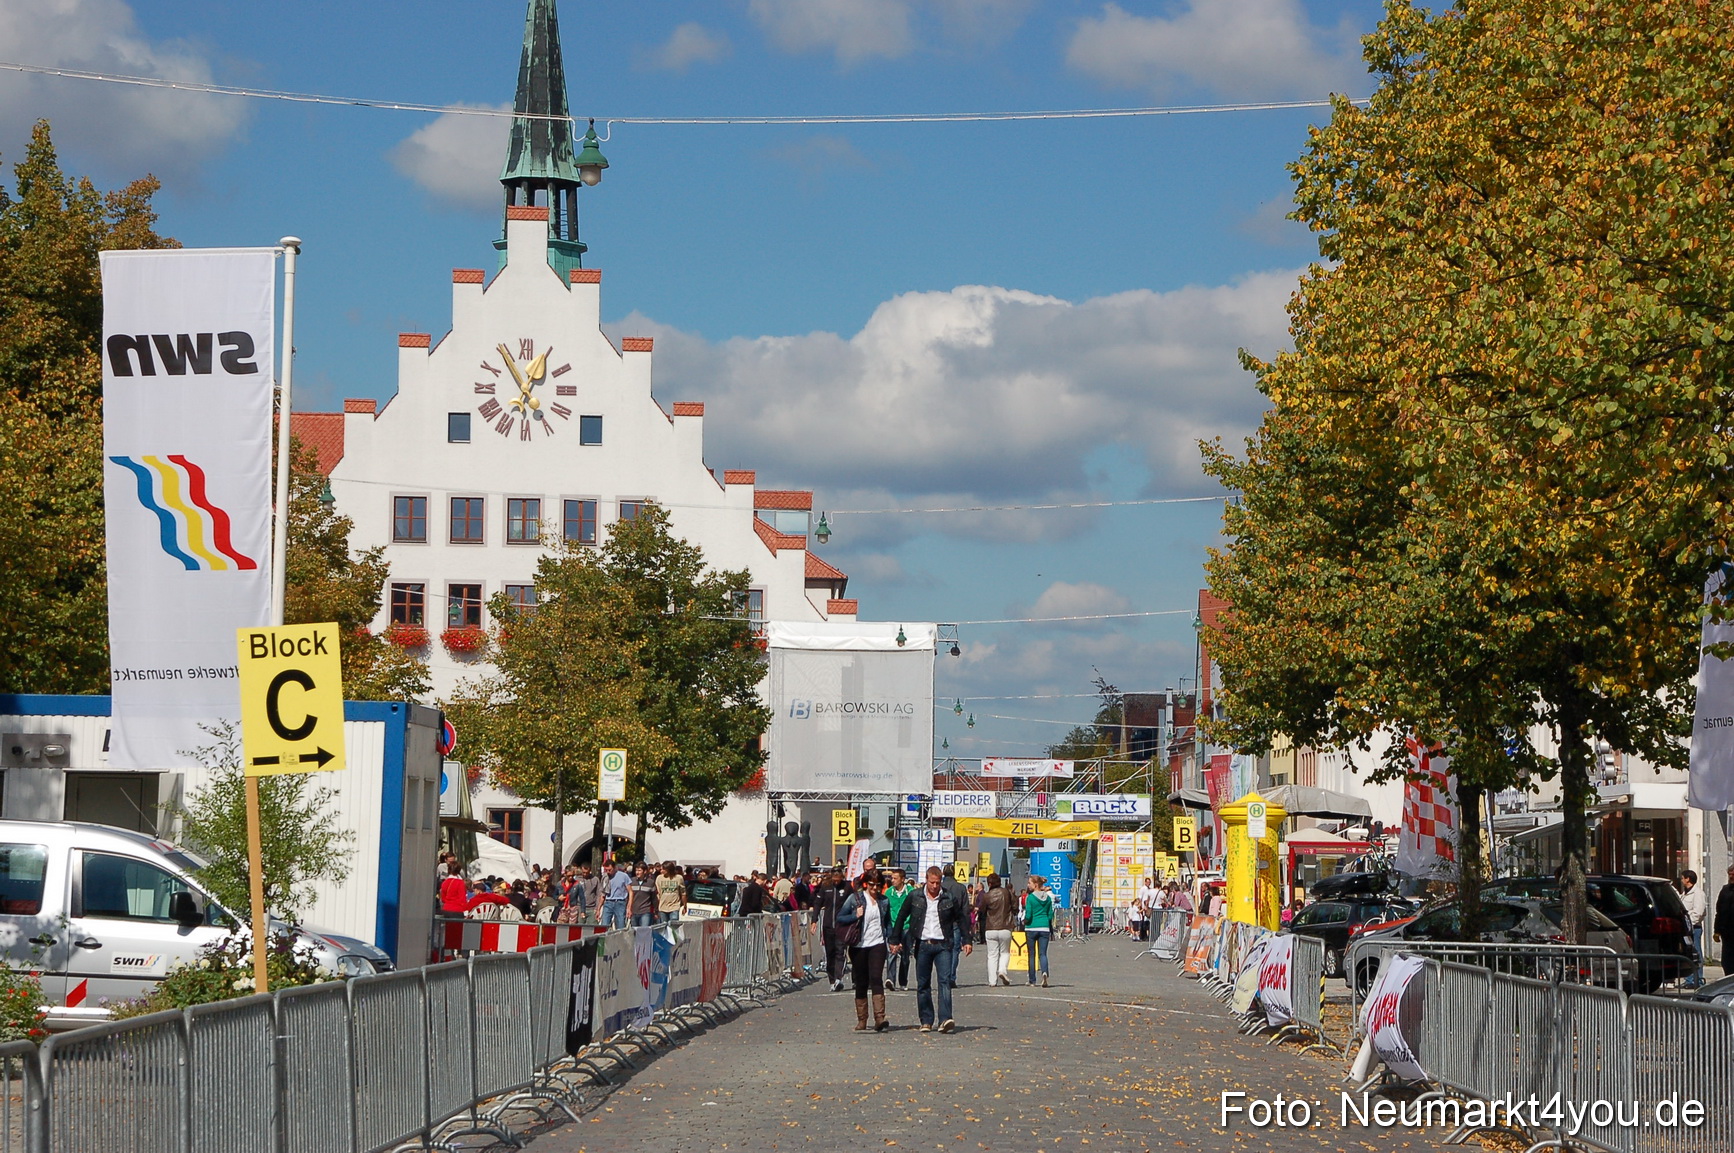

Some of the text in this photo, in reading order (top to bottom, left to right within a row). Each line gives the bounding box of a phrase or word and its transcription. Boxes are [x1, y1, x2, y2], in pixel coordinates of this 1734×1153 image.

[249, 630, 328, 659] Block
[266, 669, 318, 742] C
[815, 702, 889, 714] BAROWSKI
[893, 703, 914, 714] AG
[814, 771, 893, 780] www.barowski-ag.de
[933, 794, 991, 806] FLEIDERER
[1073, 800, 1137, 814] BOCK
[839, 820, 850, 837] B
[1011, 822, 1044, 835] ZIEL
[1180, 827, 1191, 843] B
[1058, 840, 1069, 850] dsl
[958, 868, 966, 878] A
[1168, 863, 1176, 873] A
[113, 956, 145, 966] swn
